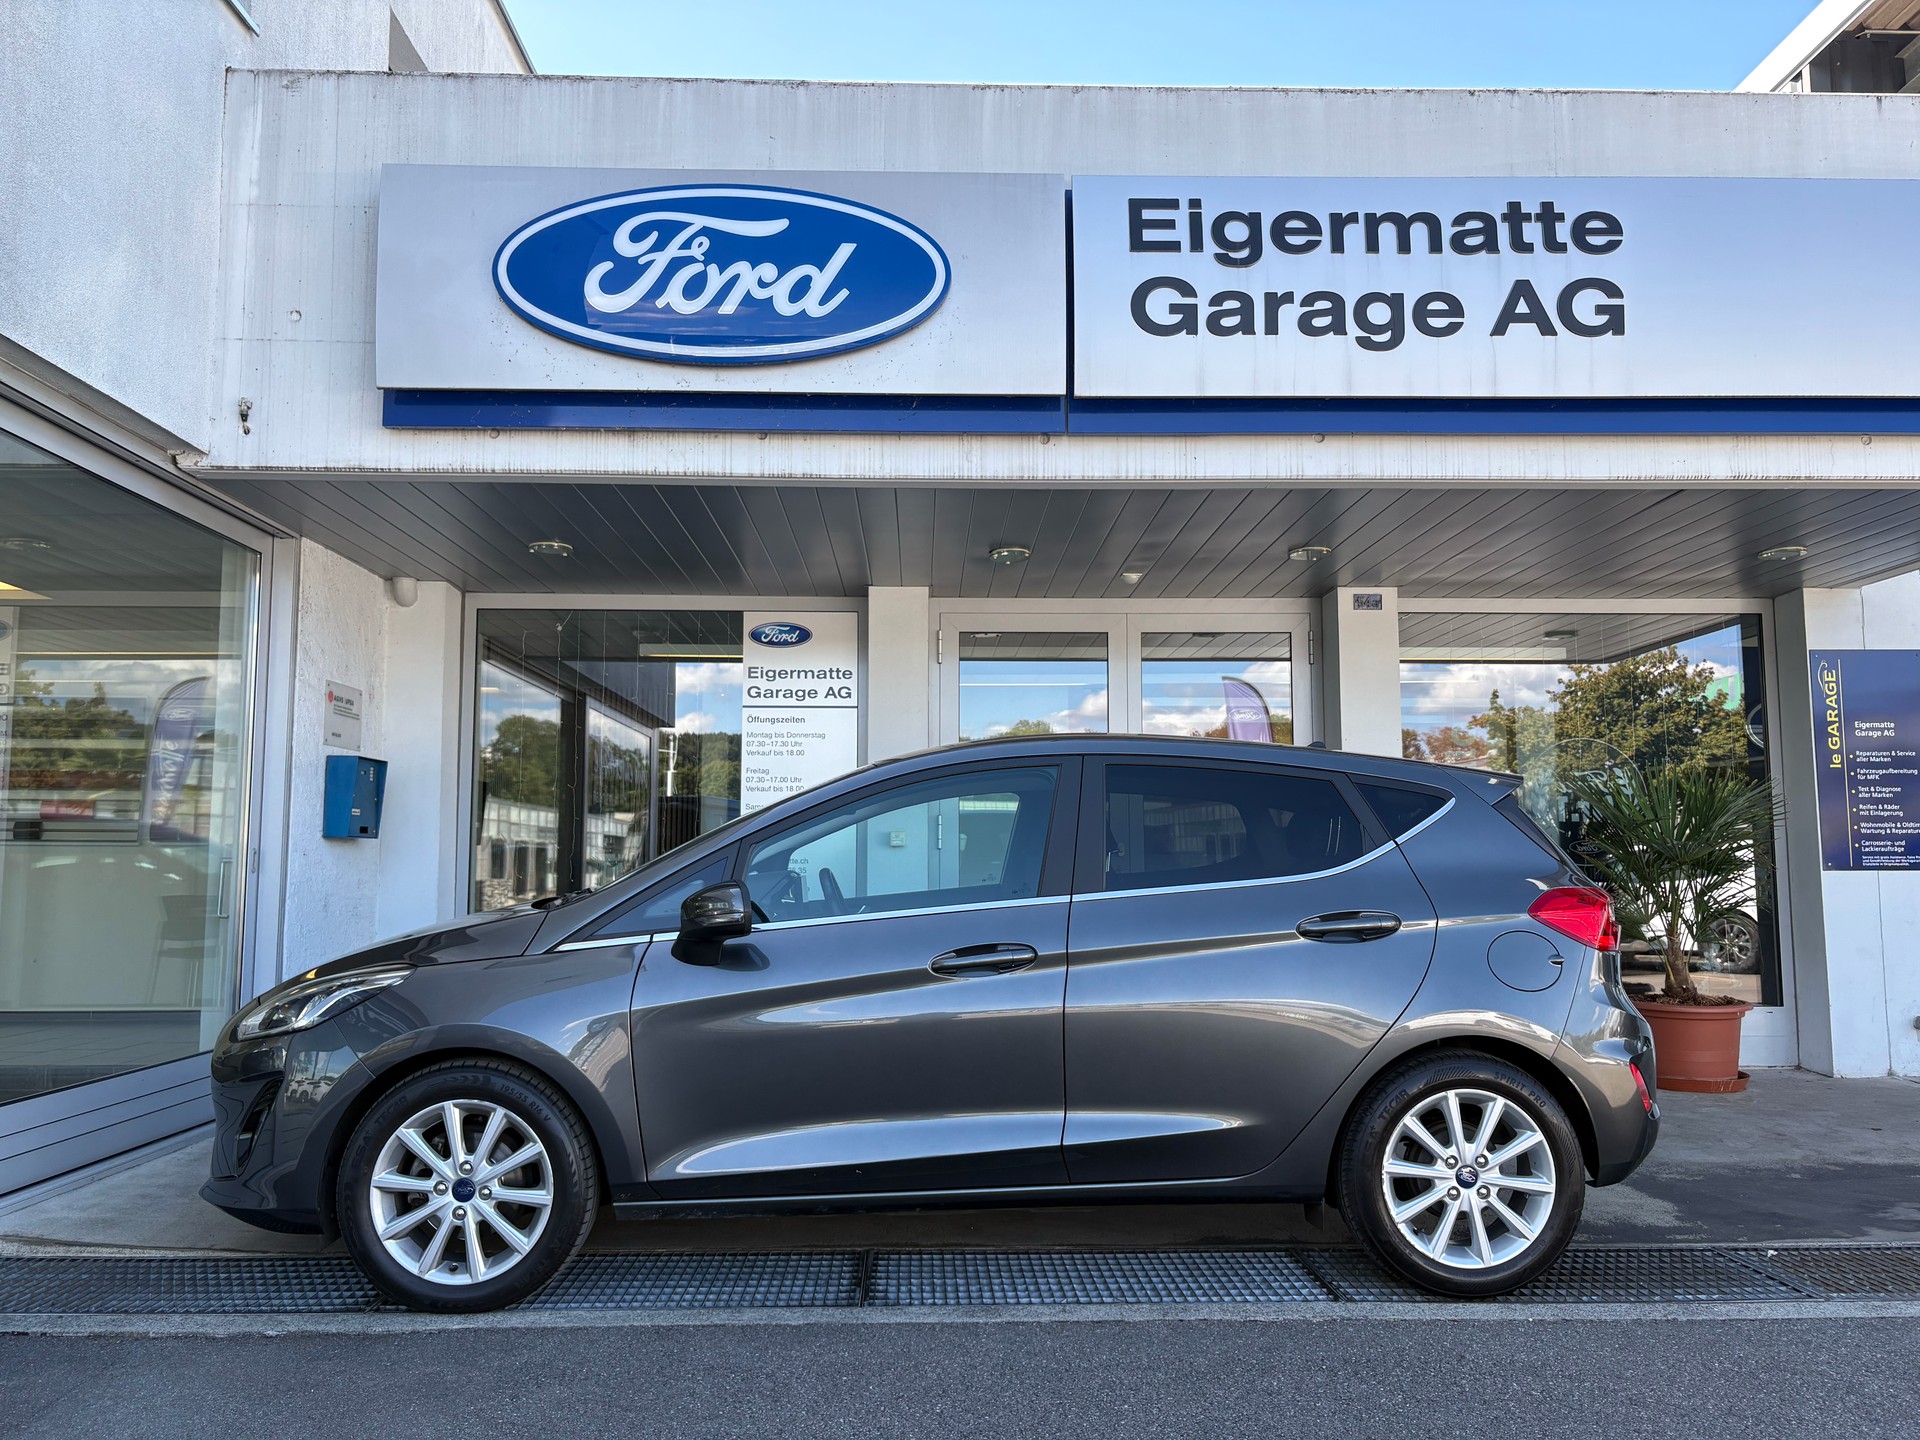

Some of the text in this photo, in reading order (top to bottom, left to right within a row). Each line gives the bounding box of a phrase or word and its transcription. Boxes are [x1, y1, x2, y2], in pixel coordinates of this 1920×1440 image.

[1127, 197, 1624, 268] Eigermatte
[583, 211, 858, 318] Ford
[1129, 276, 1625, 351] Garage AG
[761, 625, 800, 643] Ford
[747, 666, 853, 682] Eigermatte
[747, 685, 852, 701] Garage AG
[1823, 669, 1842, 768] le GARAGE
[1854, 721, 1895, 729] Eigermatte
[746, 731, 826, 739] Montag bis Donnerstag
[1855, 730, 1882, 738] Garage
[790, 740, 803, 748] Uhr
[786, 749, 805, 757] 18.00
[746, 767, 770, 775] Freitag
[1861, 845, 1905, 853] Lackieraufträge
[1493, 1071, 1547, 1108] SPIRIT PRO
[500, 1083, 529, 1103] 195/55
[528, 1100, 543, 1115] R16
[1377, 1089, 1410, 1120] TECAR
